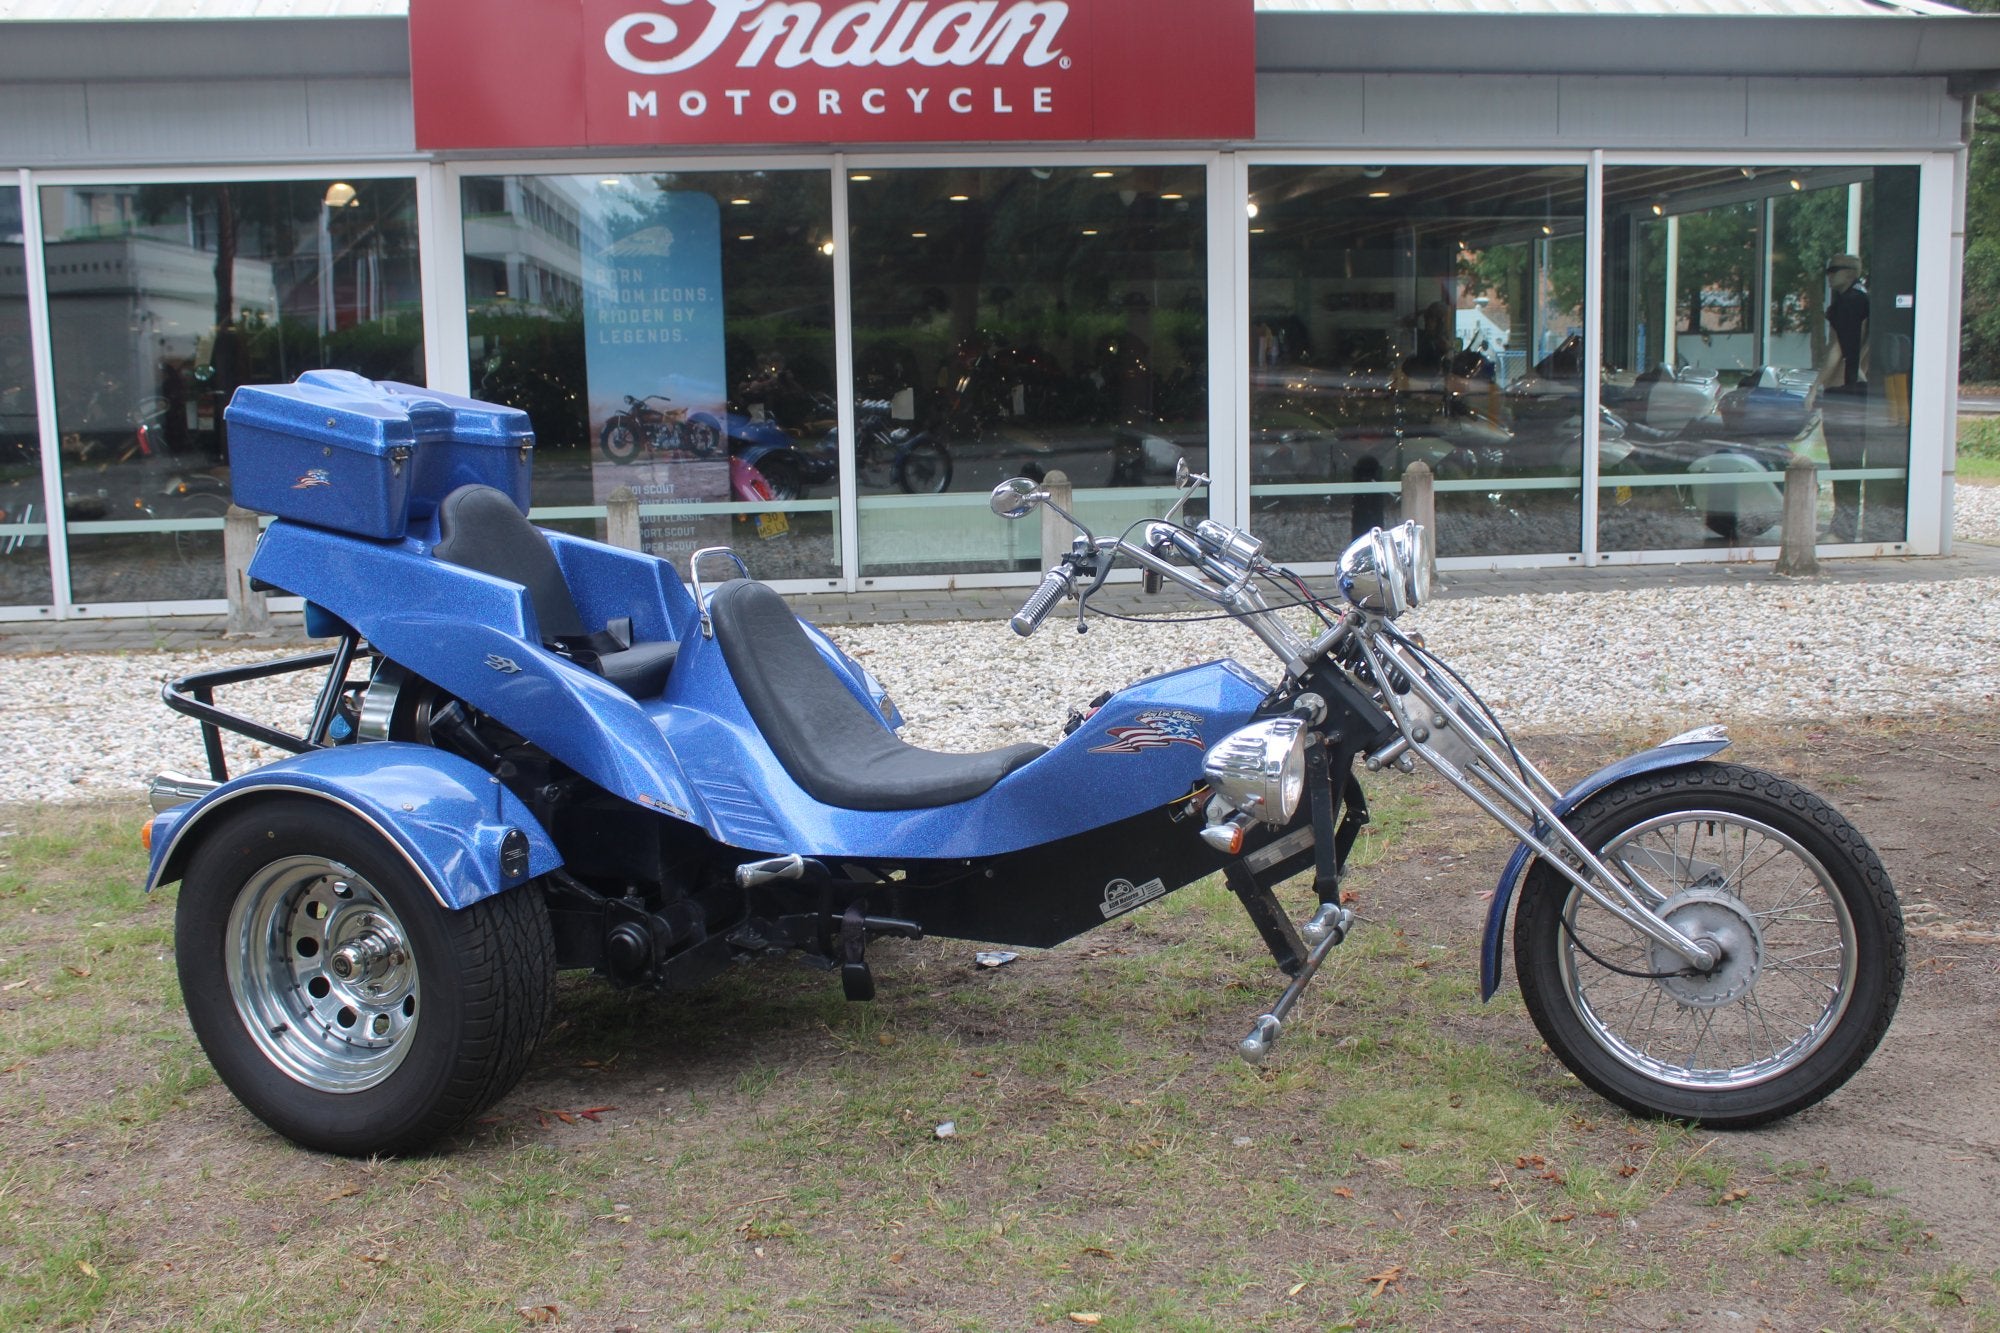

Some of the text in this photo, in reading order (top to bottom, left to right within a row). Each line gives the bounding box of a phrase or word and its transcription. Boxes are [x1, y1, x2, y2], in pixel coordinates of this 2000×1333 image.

[604, 0, 1069, 74] Indian
[628, 87, 1053, 118] MOTORCYCLE
[596, 269, 643, 283] BORN
[596, 287, 714, 304] FROM ICONS.
[598, 308, 695, 324] RIDDEN BY
[600, 328, 688, 344] LEGENDS.
[643, 483, 675, 495] SCOUT
[639, 526, 696, 538] PORT SCOUT
[666, 540, 697, 552] SCOUT
